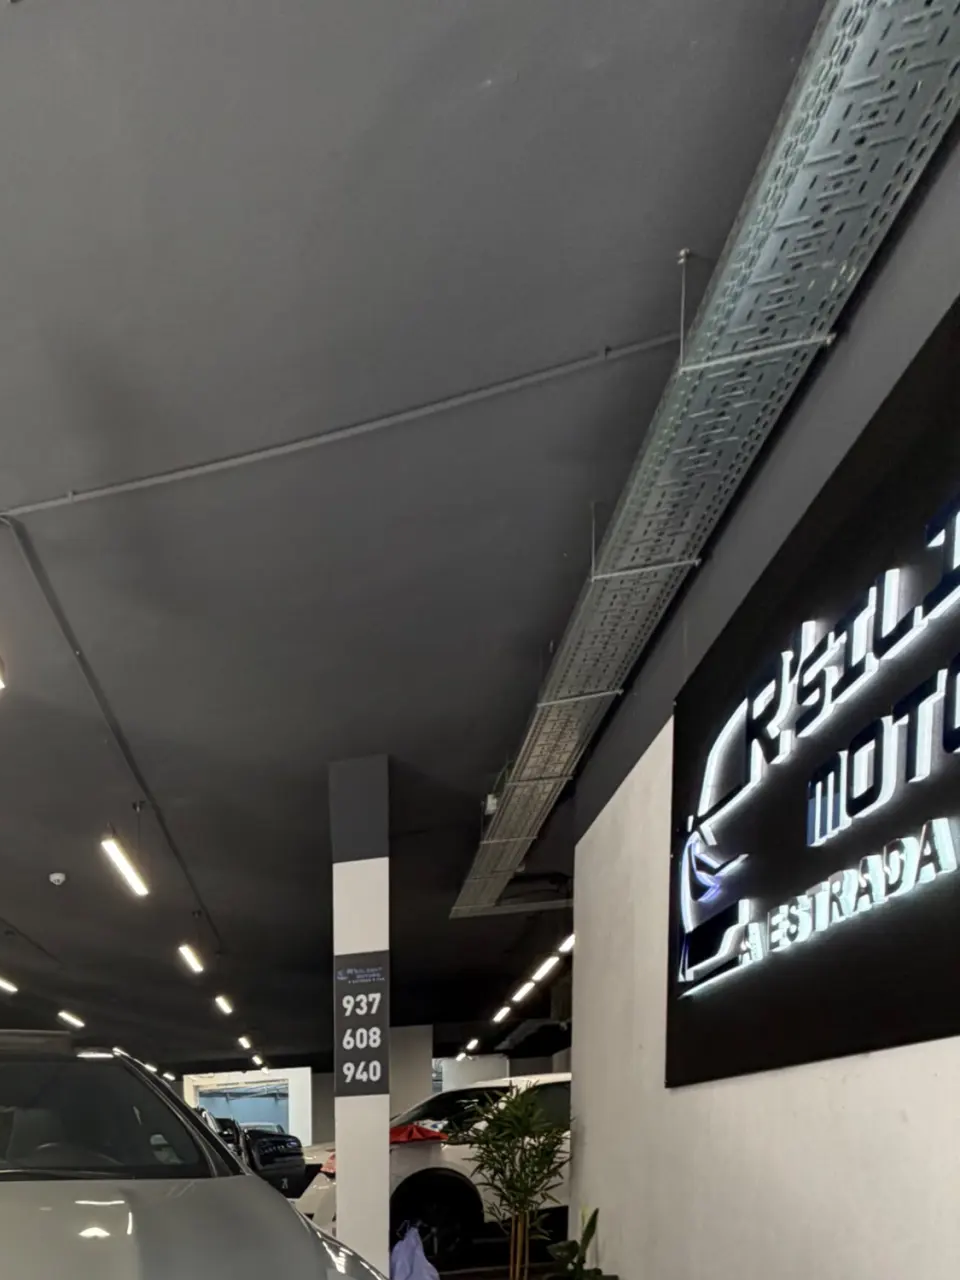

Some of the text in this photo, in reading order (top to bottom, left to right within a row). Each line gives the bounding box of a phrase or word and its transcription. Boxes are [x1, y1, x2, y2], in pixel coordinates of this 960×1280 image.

[767, 817, 957, 952] ESTRADA
[342, 993, 381, 1016] 937
[342, 1027, 381, 1049] 608
[342, 1060, 381, 1083] 940
